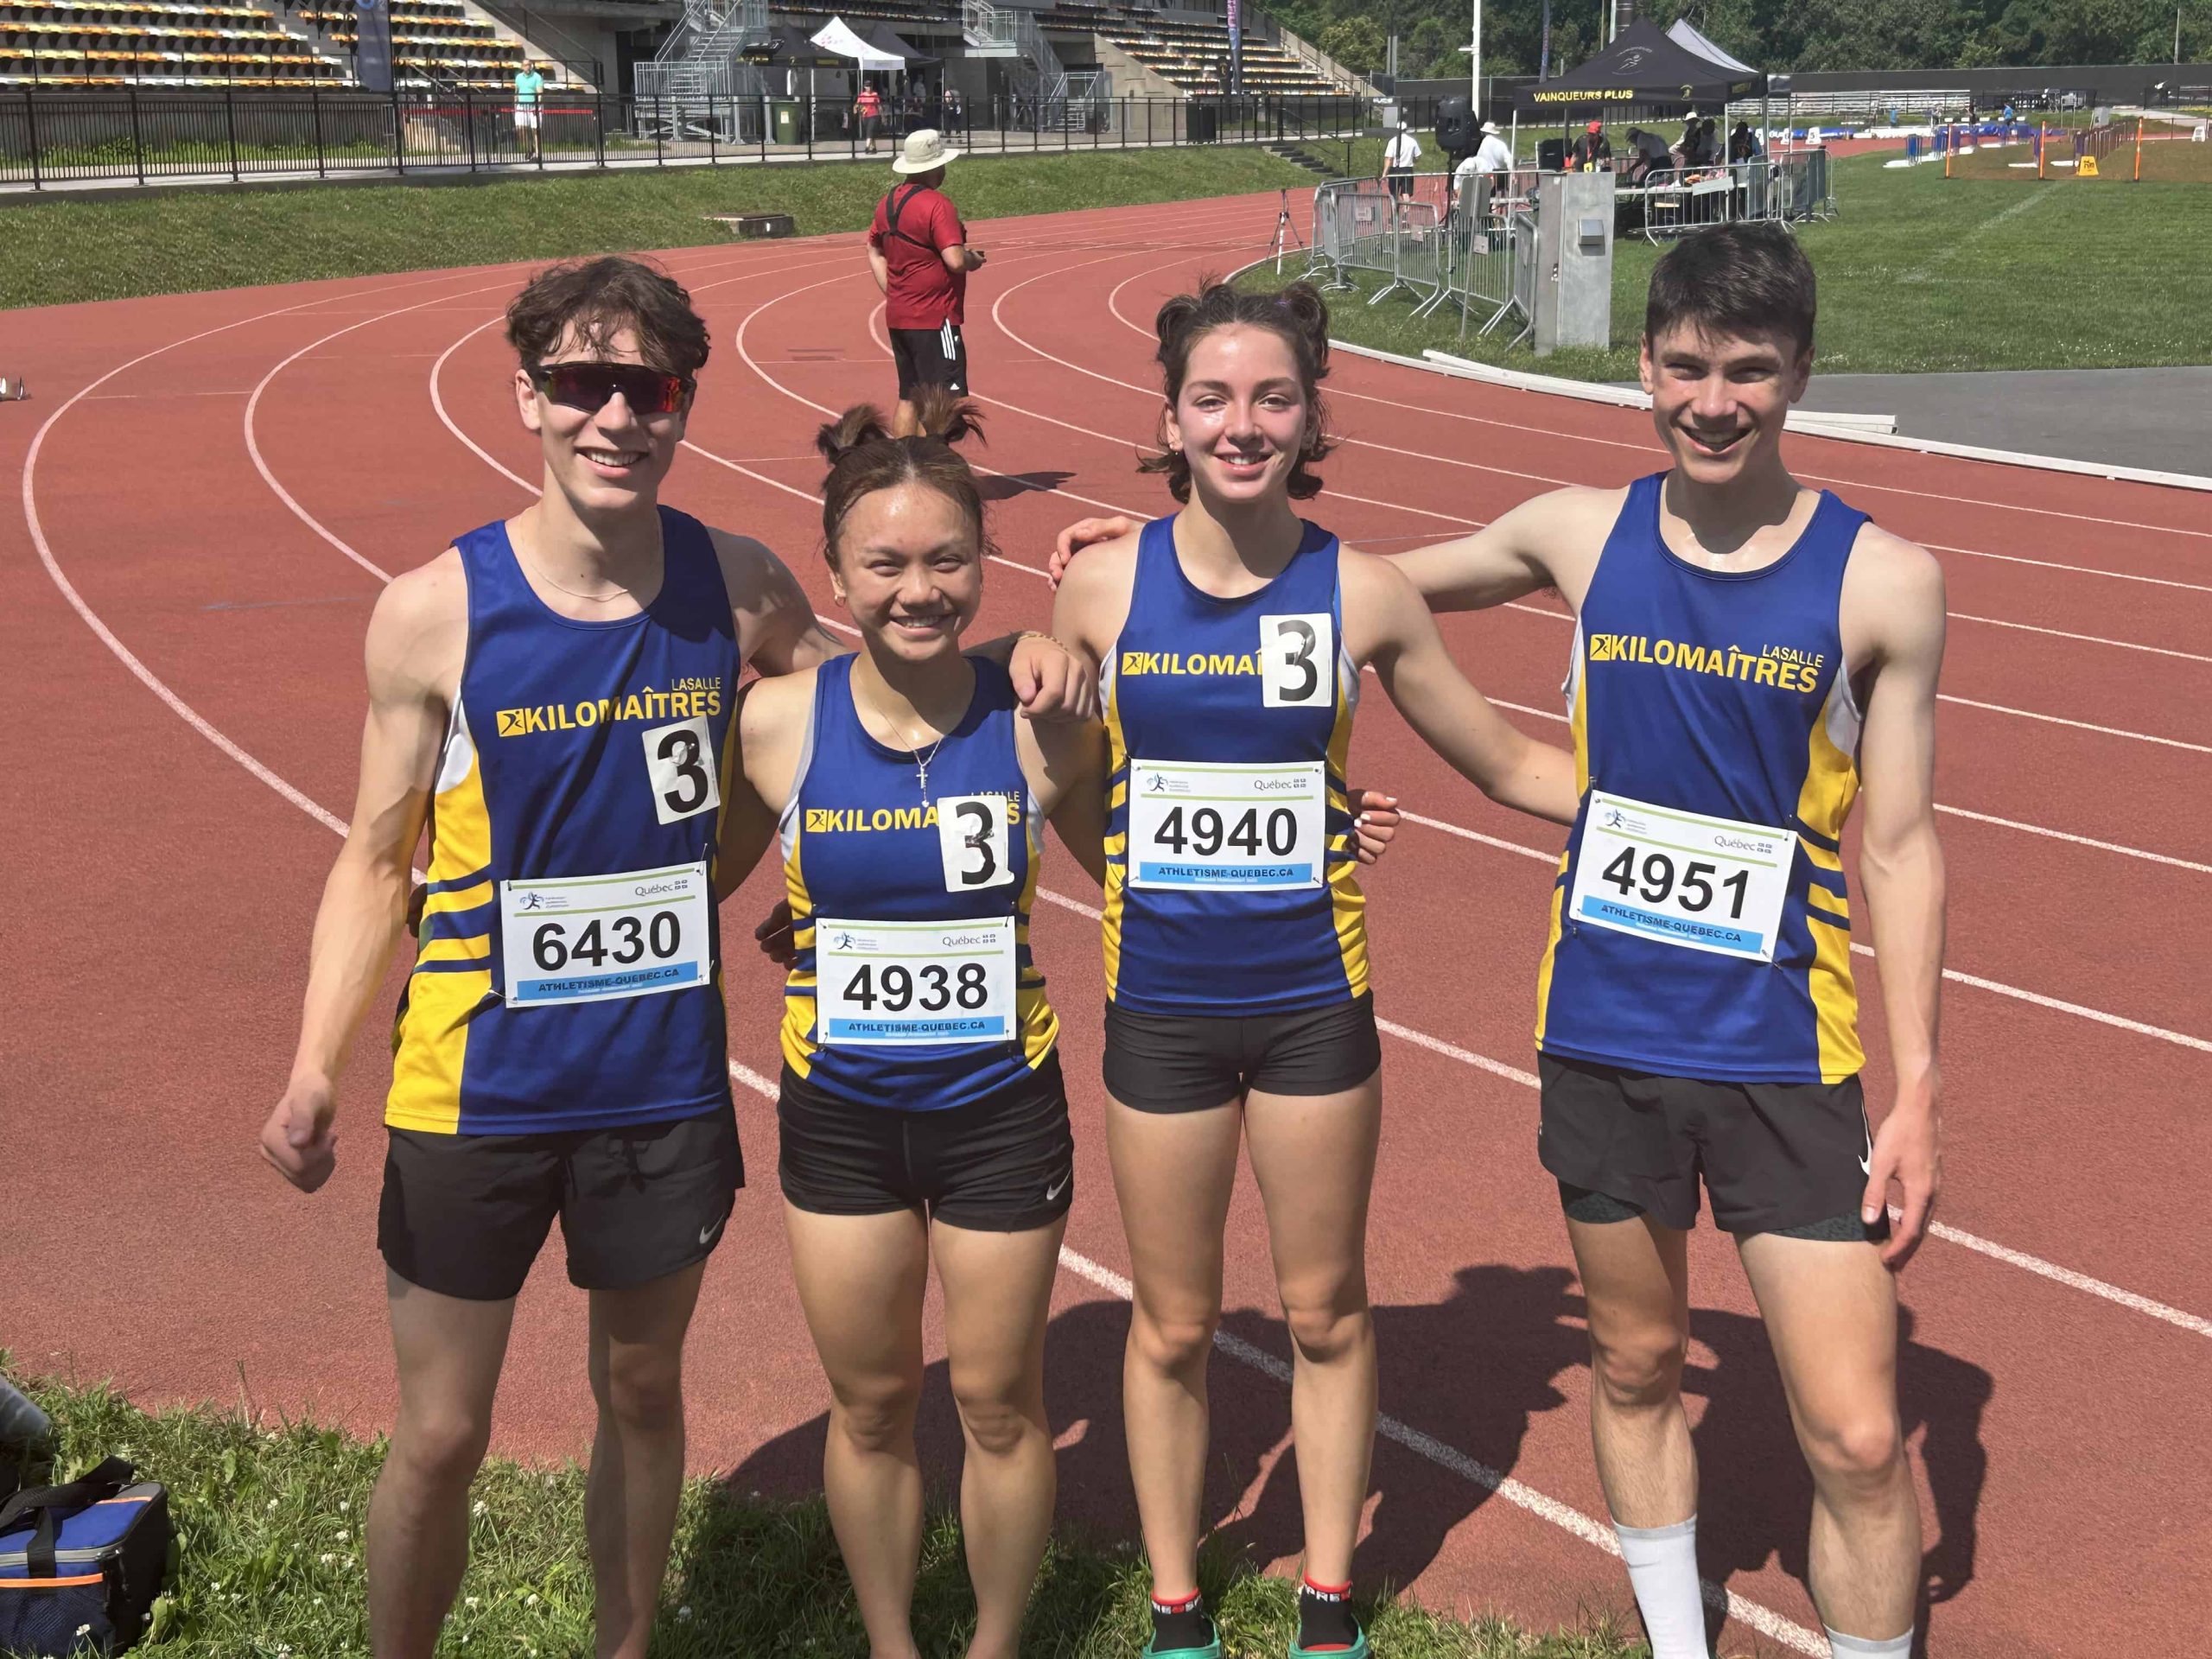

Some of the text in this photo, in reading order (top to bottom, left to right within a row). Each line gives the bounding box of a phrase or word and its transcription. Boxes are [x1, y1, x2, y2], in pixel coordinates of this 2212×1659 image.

[1534, 89, 1634, 102] VAINQUEURS PLUS
[1278, 620, 1318, 702] 3
[1610, 635, 1819, 694] KILOMAÎTRES
[1763, 645, 1824, 669] LASALLE
[671, 677, 721, 691] LASALLE
[525, 685, 721, 734] KILOMAÎTRES
[657, 729, 709, 814] 3
[827, 802, 1021, 832] KILOMAS
[1154, 806, 1298, 856] 4940
[955, 801, 997, 885] 3
[1714, 836, 1756, 851] Québec
[635, 882, 674, 897] Québec
[1158, 868, 1294, 879] ATHLETISME-QUEBEC.CA
[1603, 847, 1749, 919] 4951
[942, 935, 982, 947] Québec
[1601, 905, 1742, 943] ATHLETISME-QUEBEC.CA
[533, 912, 681, 971] 6430
[538, 969, 680, 992] ATHLETISME-QUEBEC.CA
[843, 963, 988, 1011] 4938
[849, 1021, 986, 1033] ATHLETISME-QUEBEC.CA
